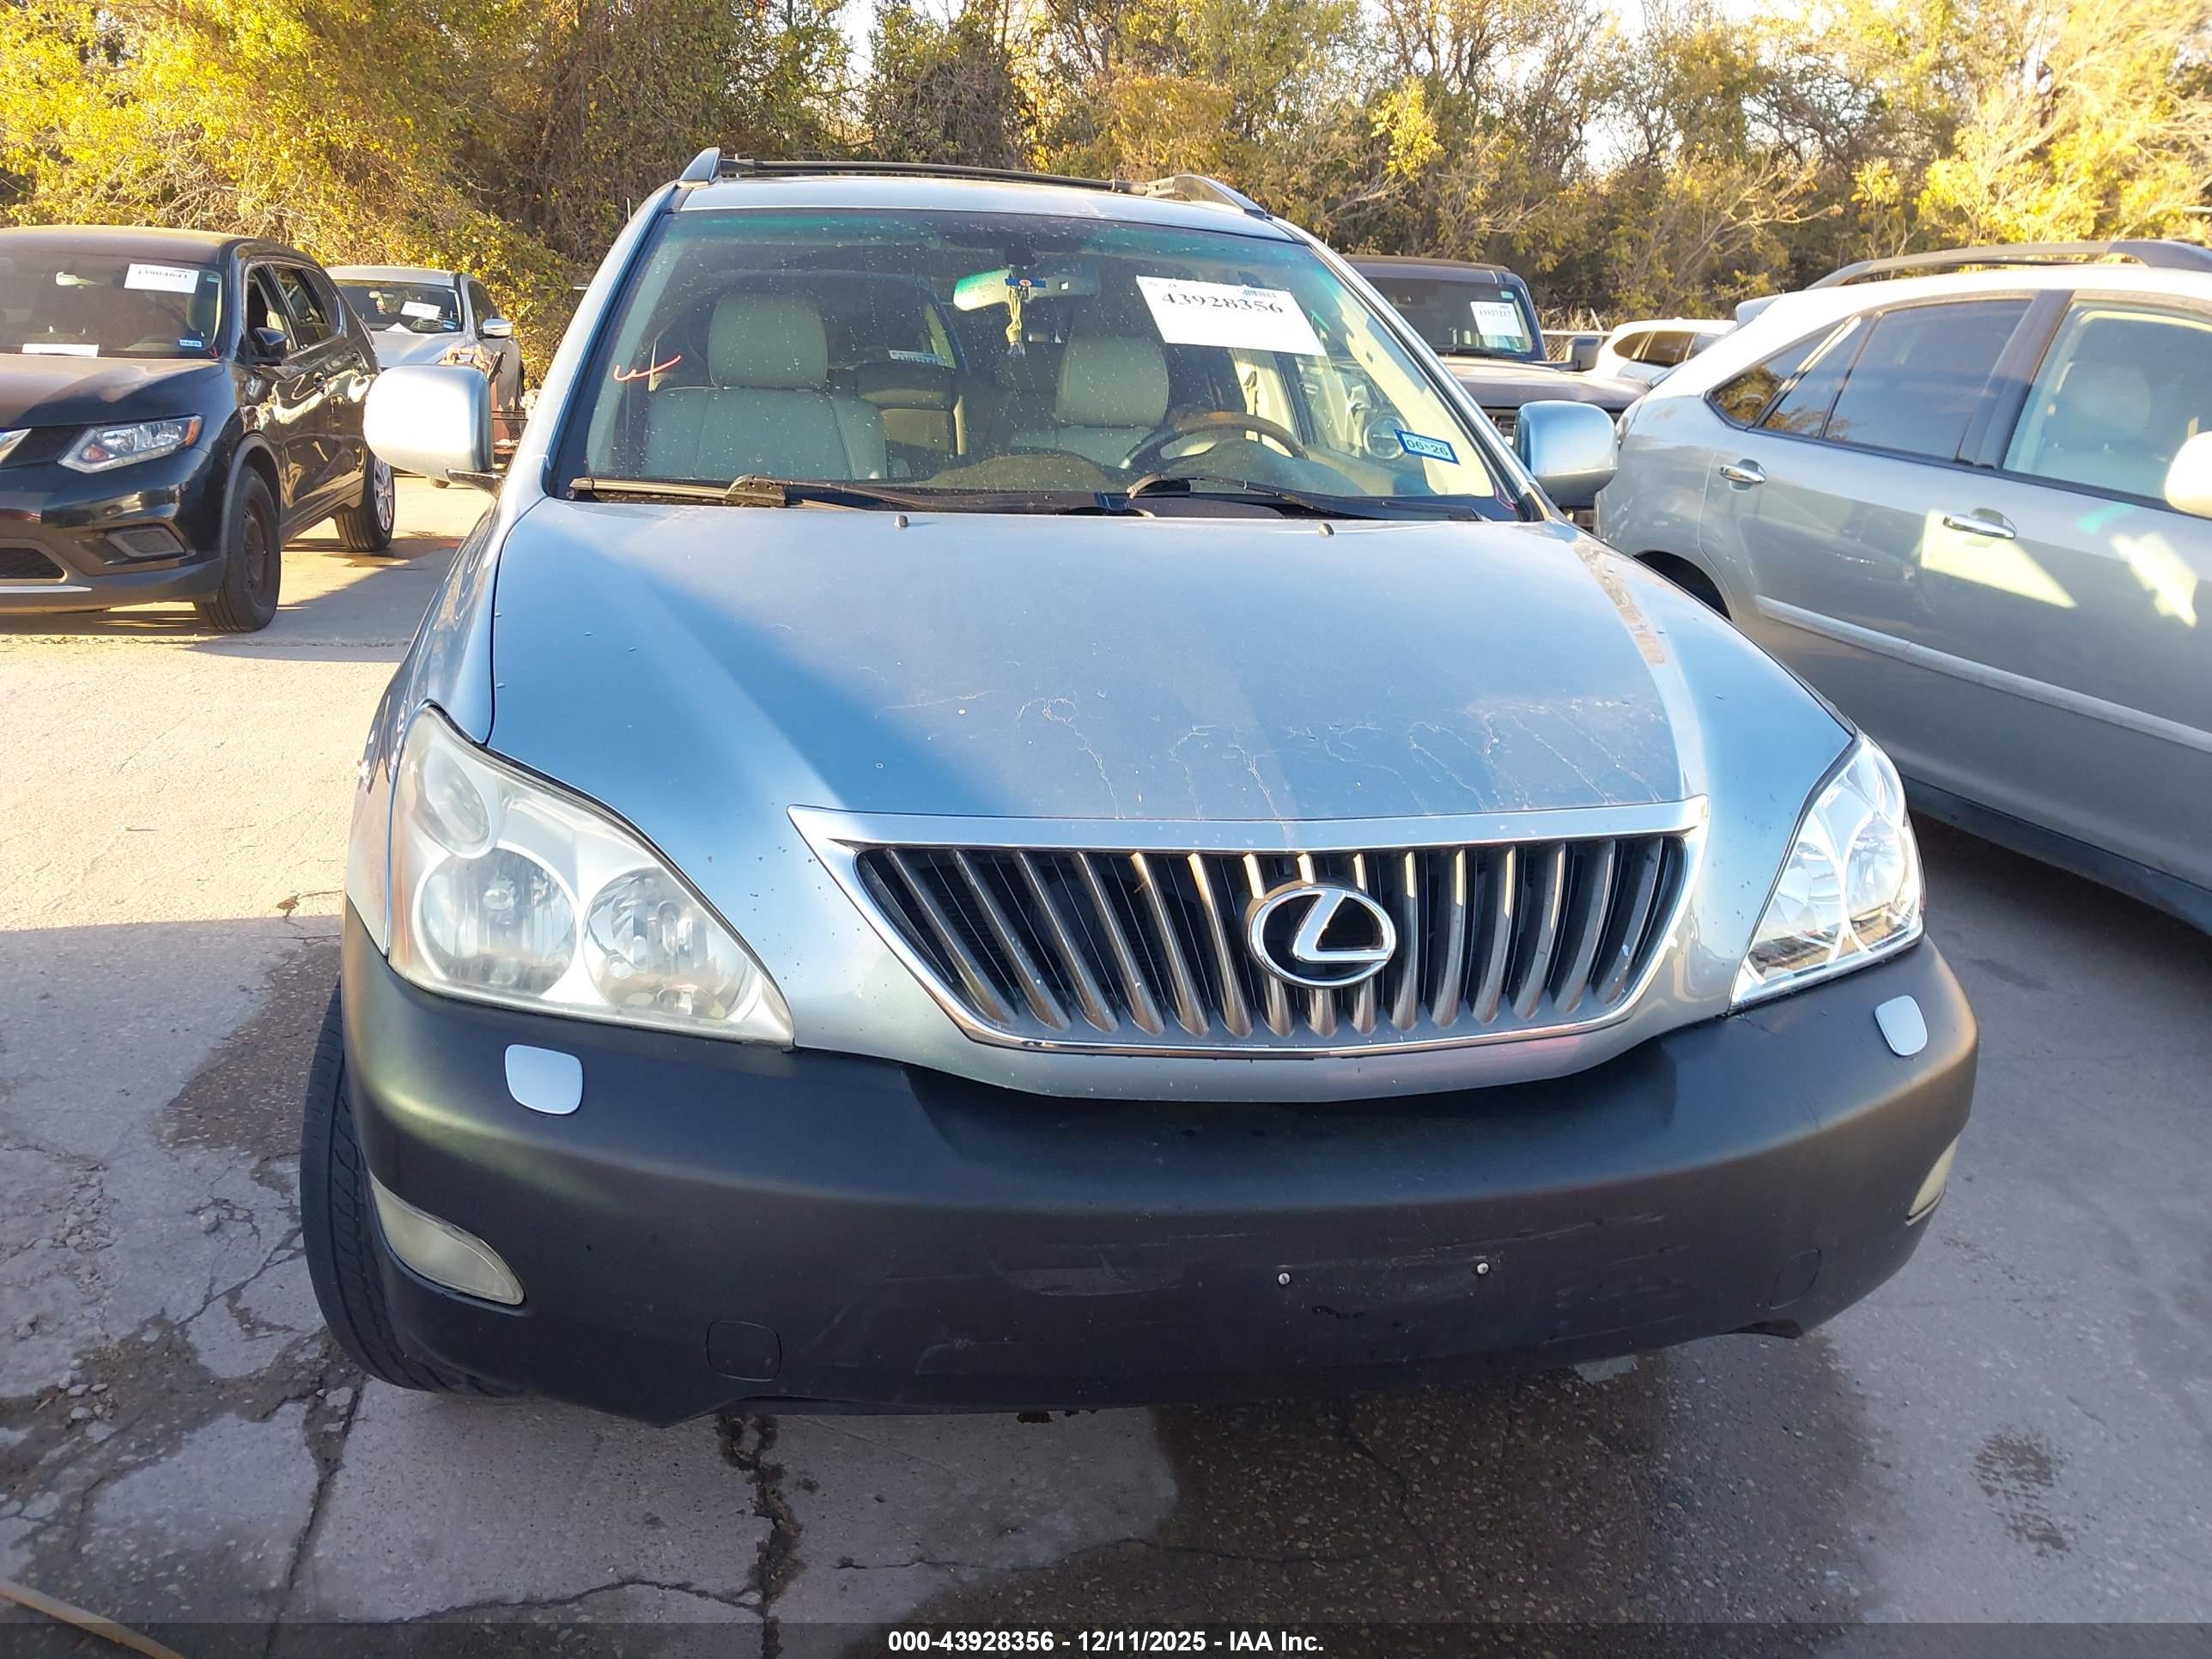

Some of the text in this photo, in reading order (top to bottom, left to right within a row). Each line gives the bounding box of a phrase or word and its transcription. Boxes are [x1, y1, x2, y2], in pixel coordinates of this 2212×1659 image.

[1162, 292, 1284, 313] 43928356
[1406, 439, 1449, 456] 06 26
